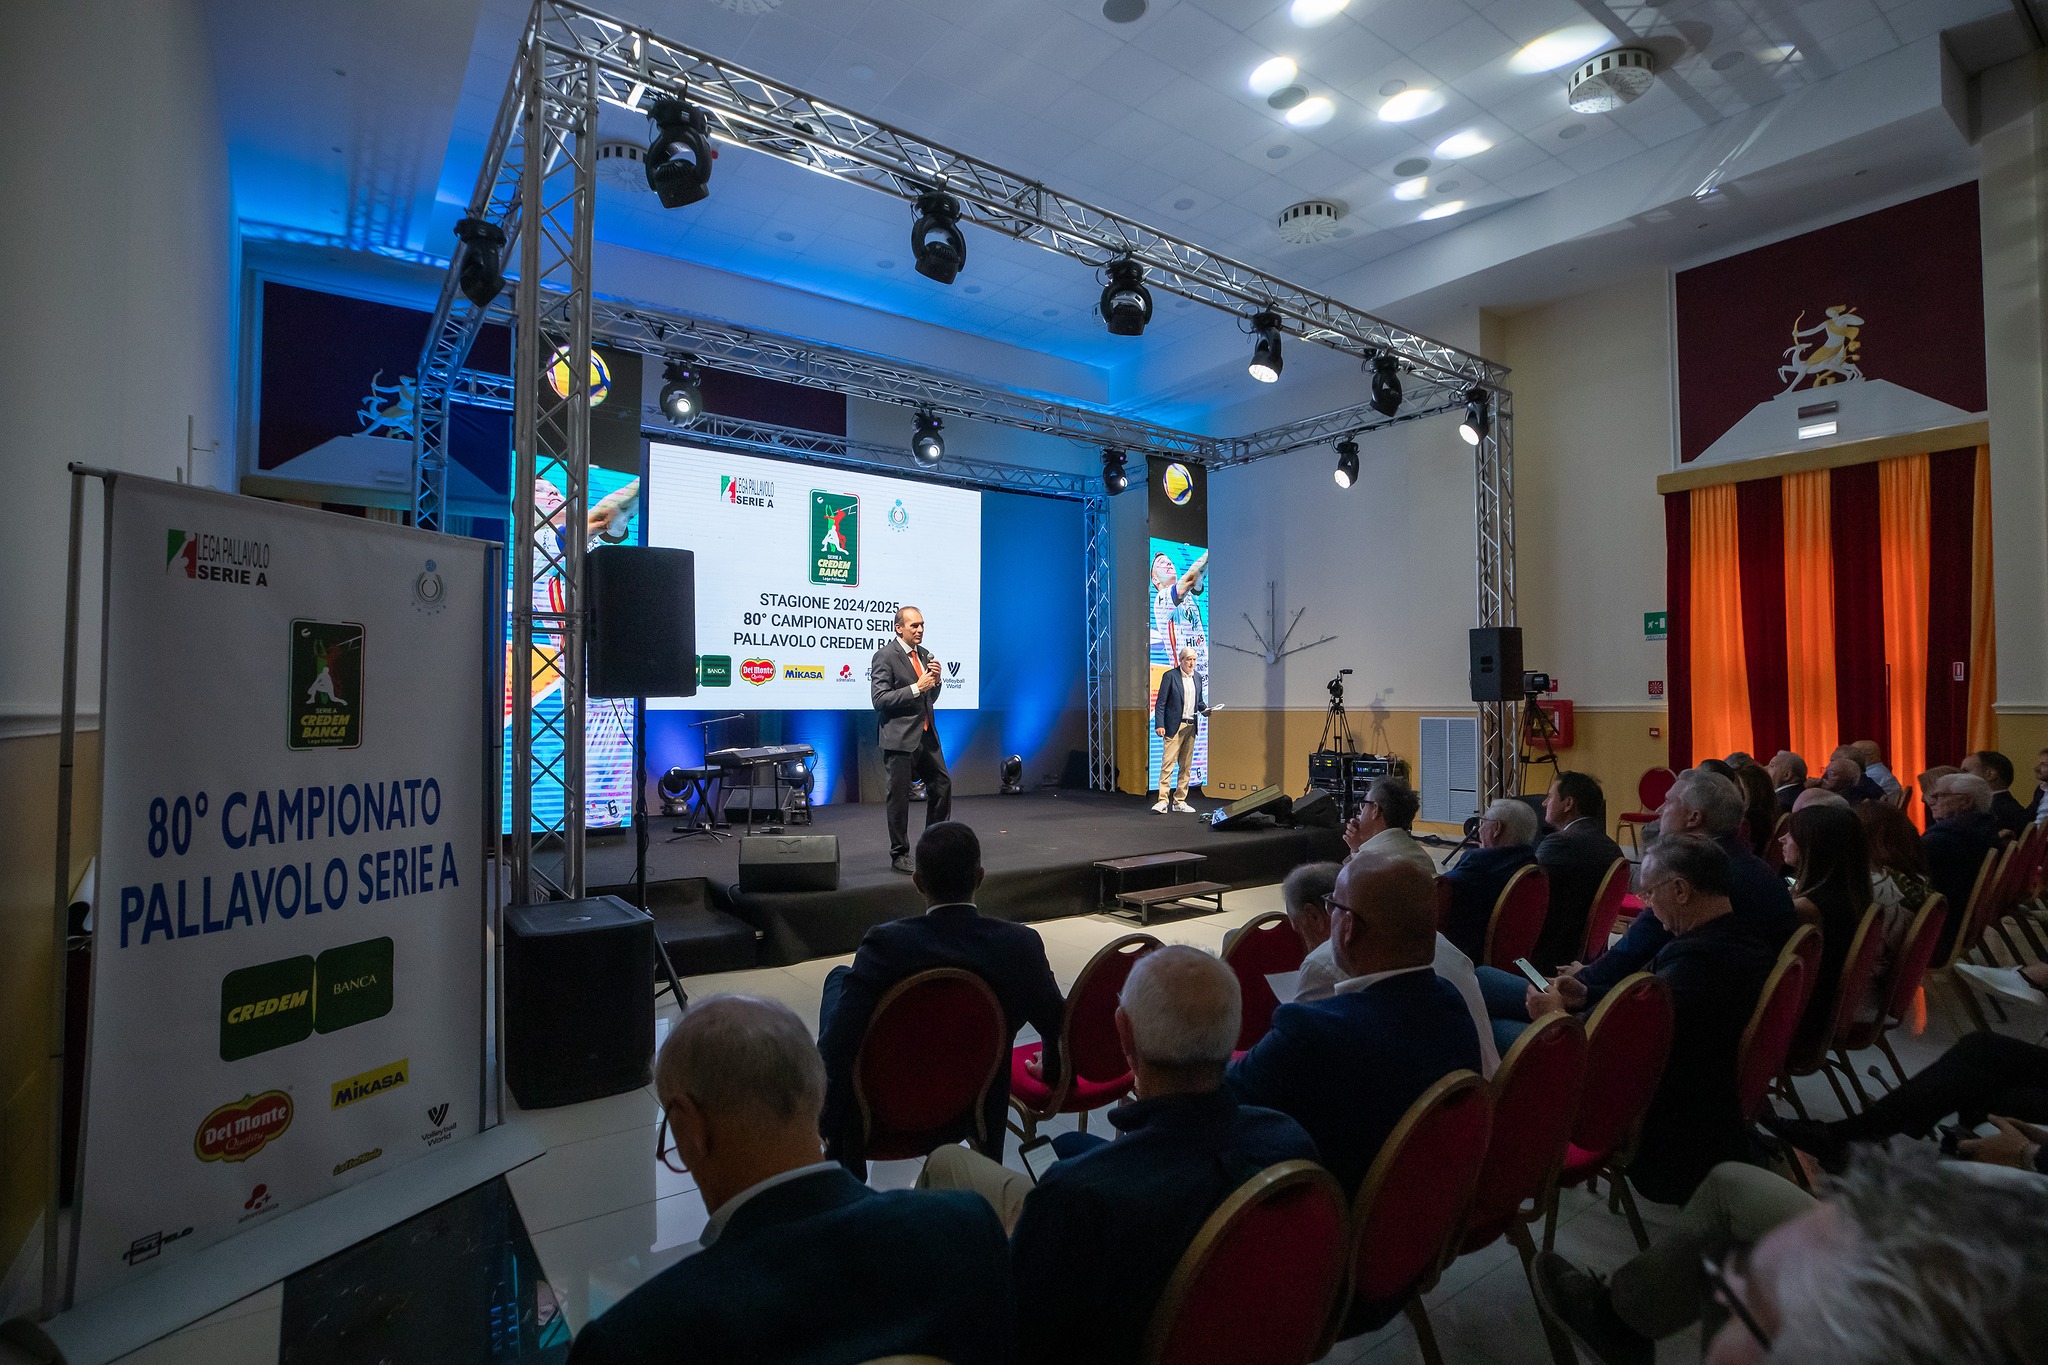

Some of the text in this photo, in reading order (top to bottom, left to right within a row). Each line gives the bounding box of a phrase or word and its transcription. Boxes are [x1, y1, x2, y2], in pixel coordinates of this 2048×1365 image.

[736, 495, 774, 508] SERIE A
[197, 534, 270, 569] LEGA PALLAVOLO
[817, 558, 852, 570] CREDEM
[818, 568, 848, 578] BANCA
[198, 565, 268, 587] SERIE A
[760, 592, 900, 614] STAGIONE 2024/2025
[743, 612, 896, 632] 80° CAMPIONATO SERI
[733, 632, 893, 650] PALLAVOLO CREDEM BA
[742, 666, 773, 674] Del Monte
[300, 714, 351, 726] CREDEM
[302, 726, 346, 738] BANCA
[607, 798, 618, 816] 6
[148, 777, 440, 858] 80° CAMPIONATO
[120, 842, 459, 949] PALLAVOLO SERIE A
[332, 974, 377, 996] BANCA
[227, 990, 310, 1024] CREDEM
[204, 1106, 287, 1146] Del Monte
[421, 1122, 457, 1141] Volleyball
[225, 1132, 265, 1151] Quality
[428, 1132, 452, 1146] World
